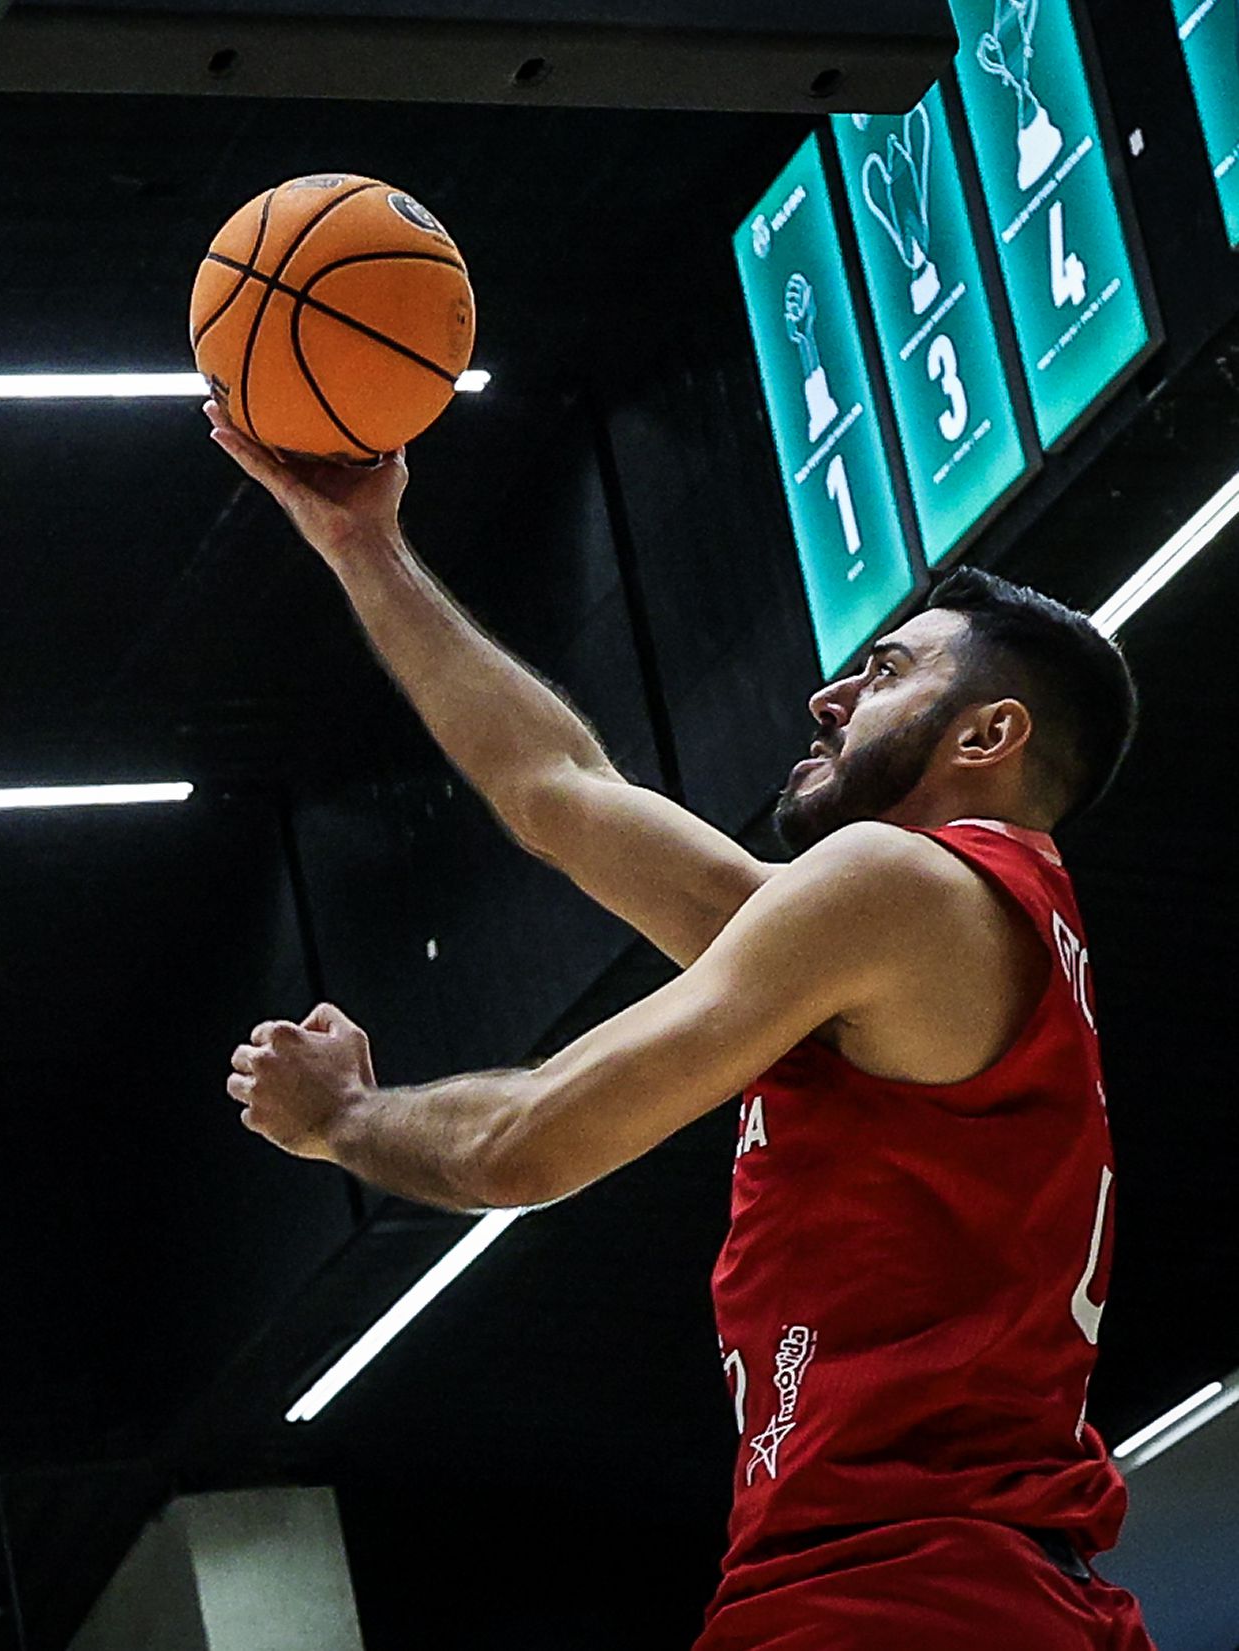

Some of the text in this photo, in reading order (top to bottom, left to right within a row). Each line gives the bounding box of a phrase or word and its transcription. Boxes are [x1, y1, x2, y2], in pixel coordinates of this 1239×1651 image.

[1048, 200, 1087, 309] 4
[927, 334, 968, 442] 3
[825, 454, 862, 555] 1
